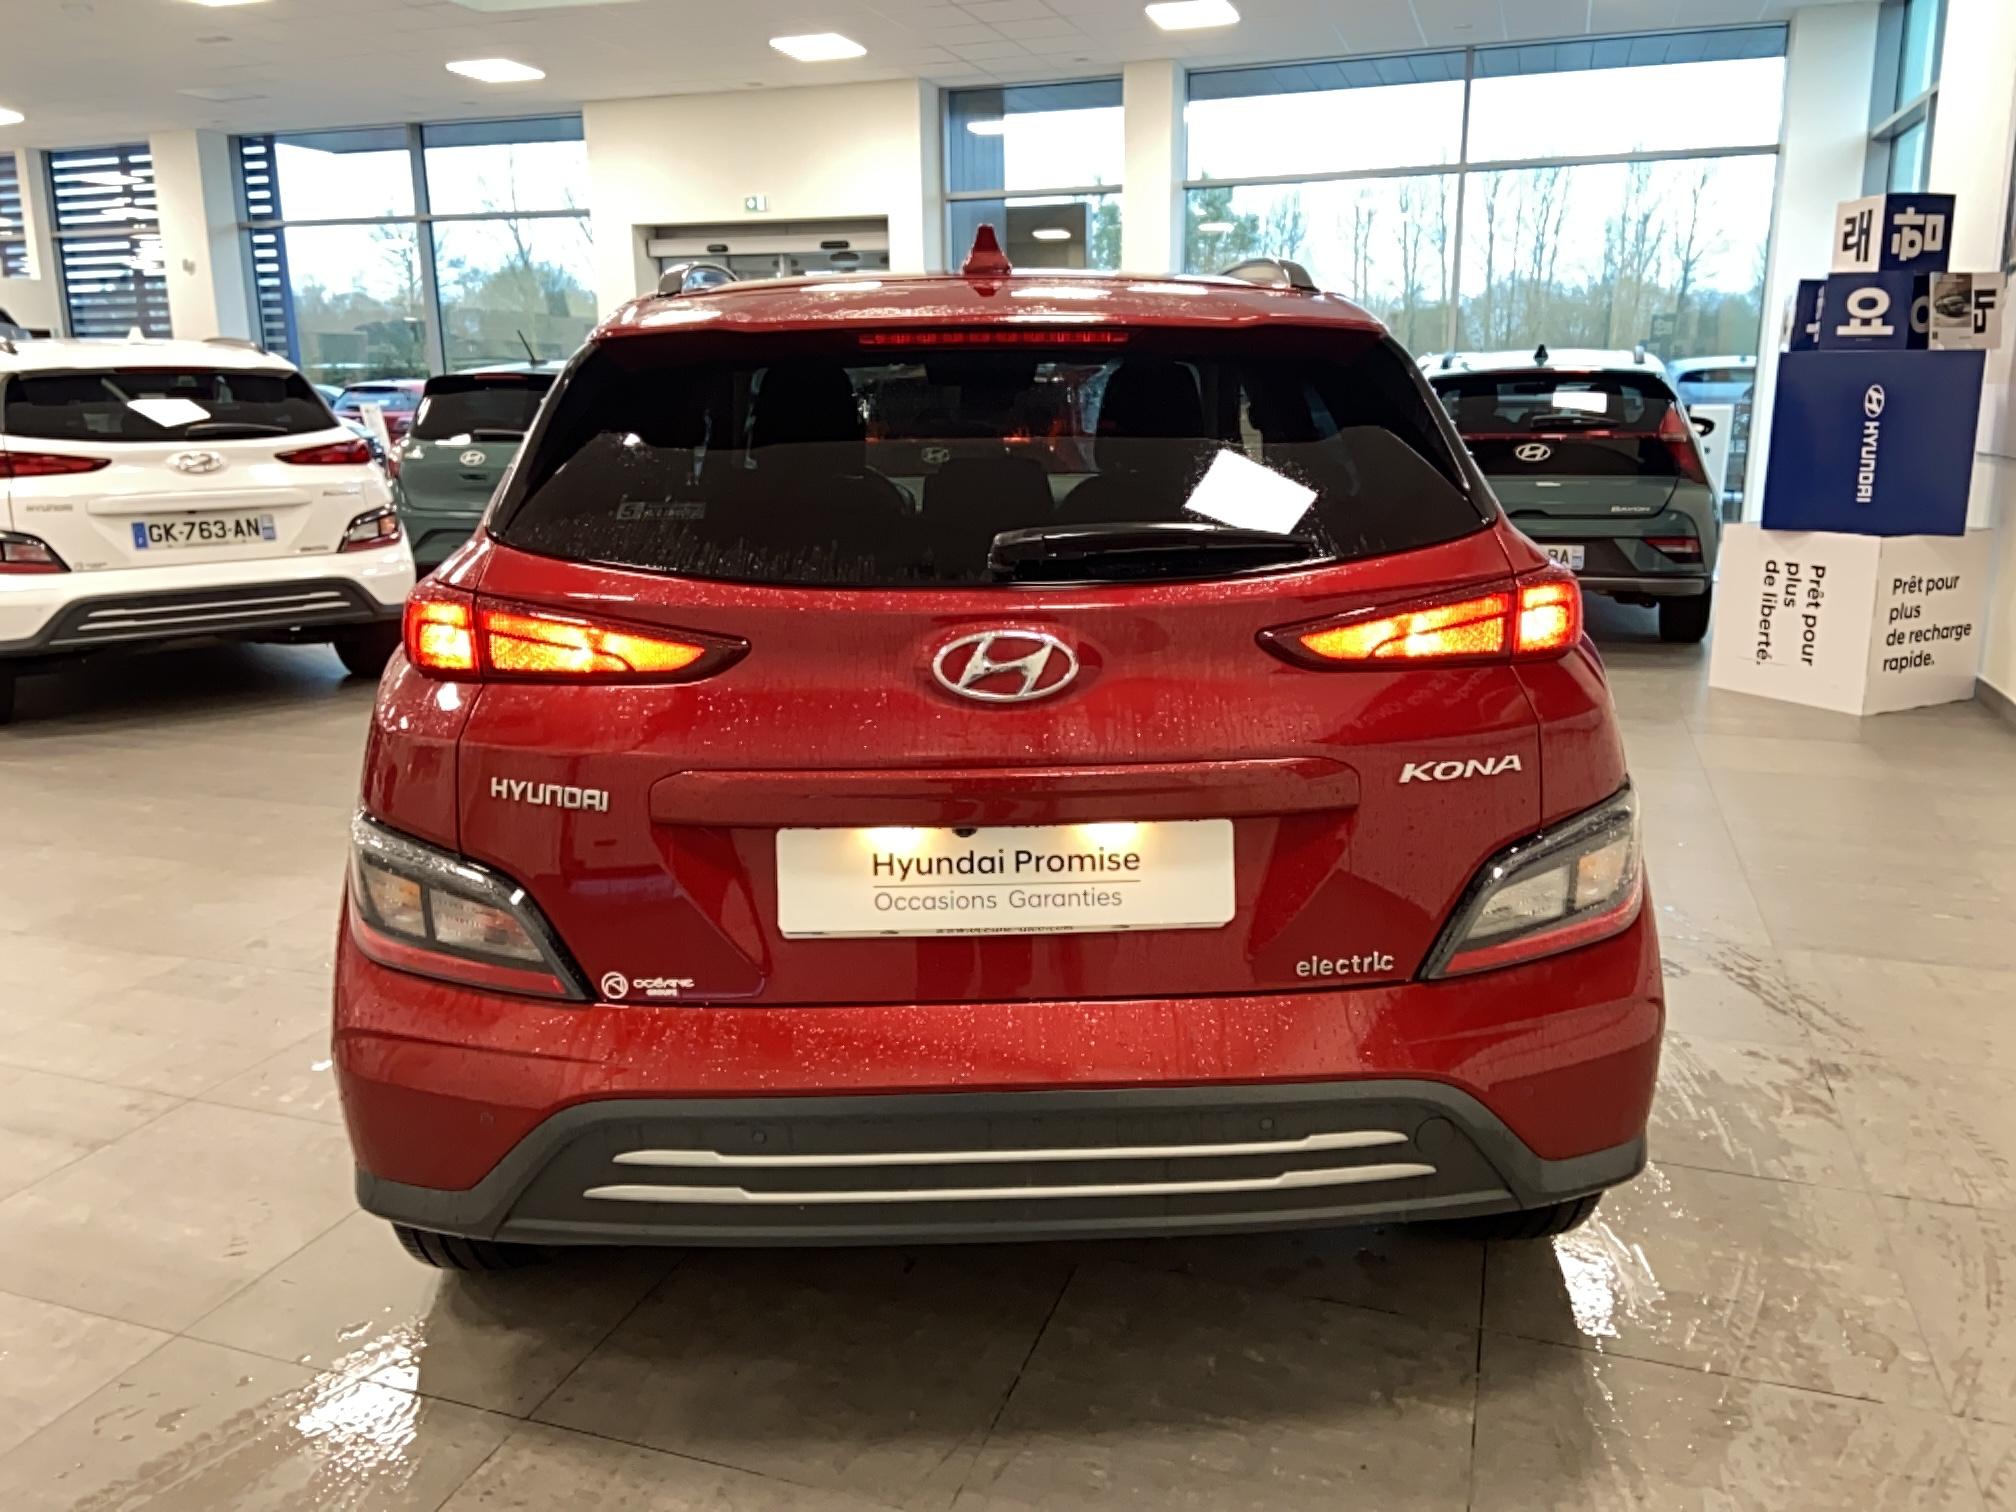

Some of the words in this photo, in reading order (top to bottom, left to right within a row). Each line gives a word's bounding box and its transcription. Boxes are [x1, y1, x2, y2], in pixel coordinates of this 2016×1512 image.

[1841, 208, 1874, 263] 래
[1890, 206, 1946, 262] 함
[1835, 286, 1895, 336] 요
[1856, 420, 1880, 503] HYUNDAI
[148, 517, 261, 543] GK-763-AN
[1763, 560, 1780, 587] de
[1783, 562, 1803, 608] plus
[1806, 565, 1827, 610] Prêt
[1892, 575, 1924, 596] Prêt
[1925, 575, 1960, 596] pour
[1756, 592, 1778, 665] liberté.
[1888, 602, 1921, 625] plus
[1801, 613, 1818, 666] pour
[1885, 628, 1905, 646] de
[1908, 623, 1972, 644] recharge
[1882, 649, 1935, 674] rapide.
[1398, 754, 1523, 784] KONA
[490, 776, 609, 812] HYUNDAI
[872, 848, 1004, 882] Hyundai
[1014, 846, 1141, 874] Promise
[874, 889, 998, 912] Occasions
[1008, 887, 1123, 909] Garanties
[1296, 950, 1395, 977] electric
